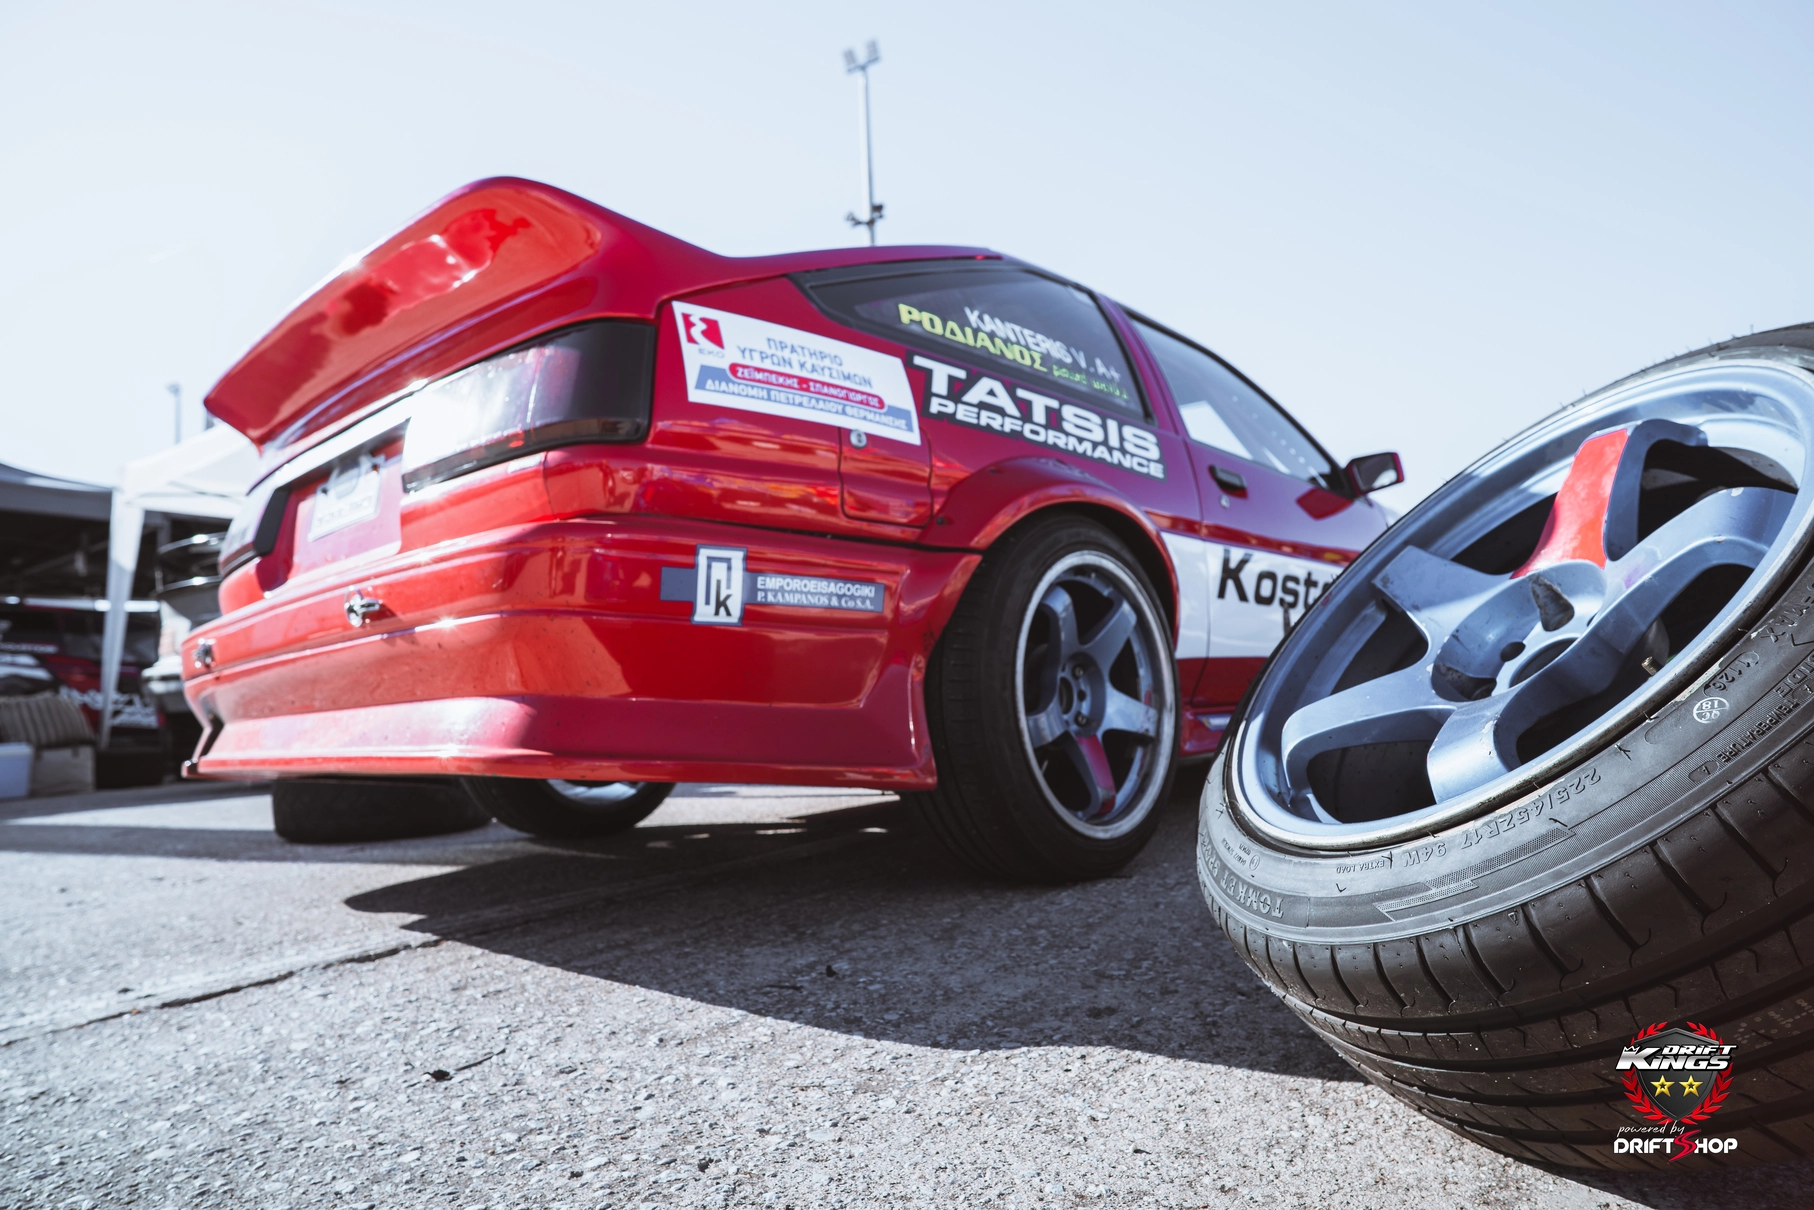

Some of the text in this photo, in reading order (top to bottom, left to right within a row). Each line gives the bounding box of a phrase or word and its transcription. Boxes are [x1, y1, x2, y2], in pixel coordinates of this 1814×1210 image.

[766, 337, 843, 367] ΠΡΑΤΗΡΙΟ
[898, 303, 1048, 372] ΡΟΔΙΑΝΟΣ
[737, 345, 873, 389] ΥΓΡΩΝ ΚΑΥΣΙΜΩΝ
[705, 379, 768, 400] ΔΙΑΝΟΜΗ
[771, 390, 844, 414] ΠΕΤΡΕΛΑΙΟΥ
[913, 355, 1160, 461] TATSIS
[929, 396, 1165, 479] PERFORMANCE
[757, 576, 875, 598] EMPOROEISAGOGIKI
[769, 591, 829, 604] KAMPANOS
[1716, 699, 1799, 763] TEMPERATURE
[1336, 768, 1602, 874] 225/45ZR17 94W EXTRA LOAD
[1220, 869, 1285, 919] TOMKET
